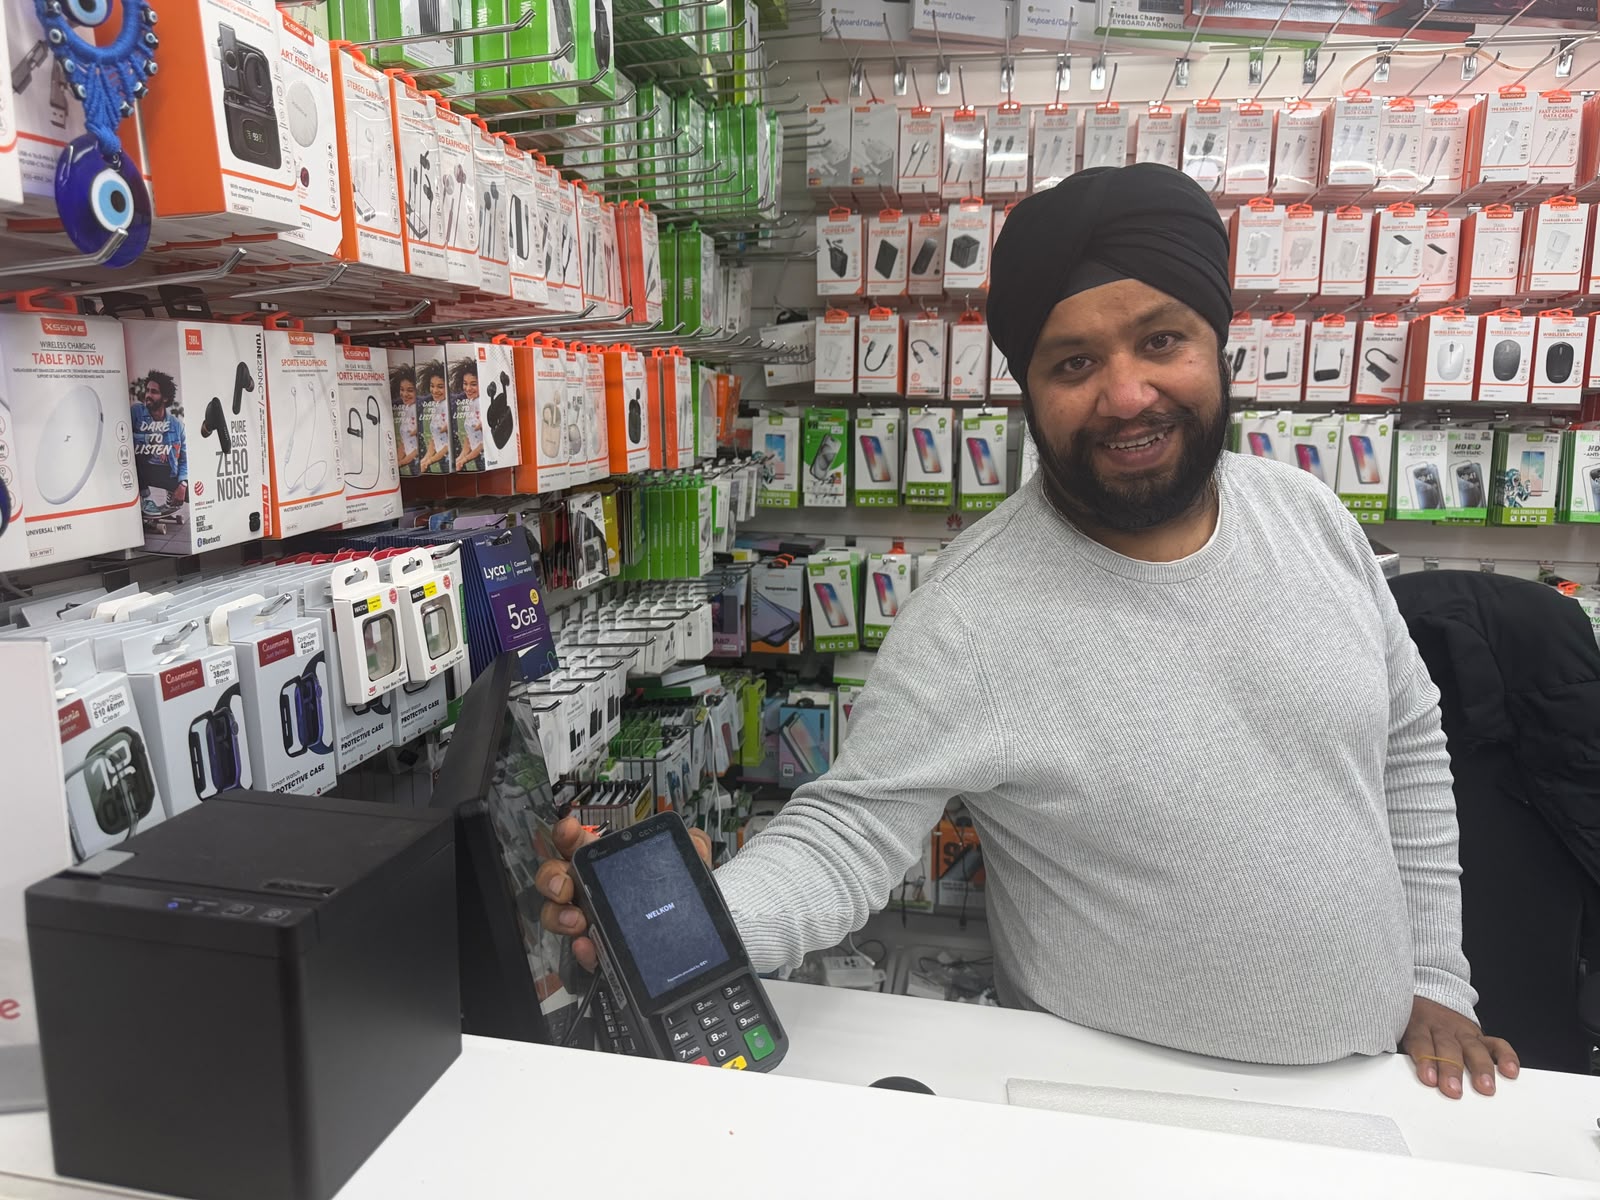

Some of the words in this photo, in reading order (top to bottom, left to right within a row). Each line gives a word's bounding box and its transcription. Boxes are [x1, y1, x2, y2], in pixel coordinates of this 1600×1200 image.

[1027, 16, 1079, 27] Keyboard/Claier
[1140, 14, 1165, 22] Charge
[284, 20, 314, 44] XSSIVE
[295, 54, 316, 74] FINDER
[317, 68, 329, 82] TAG
[446, 136, 471, 153] EARPHONES
[45, 322, 86, 332] XSSIVE
[40, 340, 67, 349] WIRELESS
[67, 342, 96, 350] CHARGING
[32, 352, 64, 365] TABLE
[65, 353, 85, 366] PAD
[86, 354, 104, 366] 15W
[281, 359, 299, 367] SPORTS
[300, 359, 328, 367] HEADPHONE
[354, 372, 385, 381] HEADPHONE
[140, 420, 170, 432] DARE
[231, 420, 247, 434] PURE
[149, 433, 163, 443] TO
[231, 434, 248, 449] BASS
[135, 444, 173, 456] LISTEN
[216, 448, 249, 478] ZERO
[217, 475, 250, 502] NOISE
[26, 526, 54, 537] UNIVERSAL
[56, 523, 73, 532] WHITE
[484, 564, 506, 580] Lyca
[354, 603, 368, 614] WATCH
[507, 603, 538, 630] 5GB
[300, 639, 315, 649] 42mm
[213, 668, 231, 679] 38mm
[216, 675, 230, 686] Black
[94, 706, 106, 720] S10
[106, 699, 126, 713] 46mm
[401, 707, 427, 725] PROTECTIVE
[428, 699, 440, 710] CASE
[102, 711, 121, 724] Clear
[341, 732, 351, 742] Smart
[352, 726, 364, 737] Watch
[341, 731, 371, 751] PROTECTIVE
[371, 722, 385, 735] CASE
[309, 763, 325, 777] CASE
[271, 777, 286, 789] Smart
[285, 769, 300, 782] Watch
[646, 902, 675, 920] WELKOM
[725, 987, 734, 995] 3
[696, 1002, 705, 1011] 2
[733, 1001, 741, 1010] 6
[703, 1017, 712, 1026] 5
[740, 1017, 748, 1027] 9
[674, 1032, 681, 1041] 4
[711, 1033, 719, 1042] 8
[680, 1049, 688, 1059] 7
[718, 1048, 727, 1057] 0
